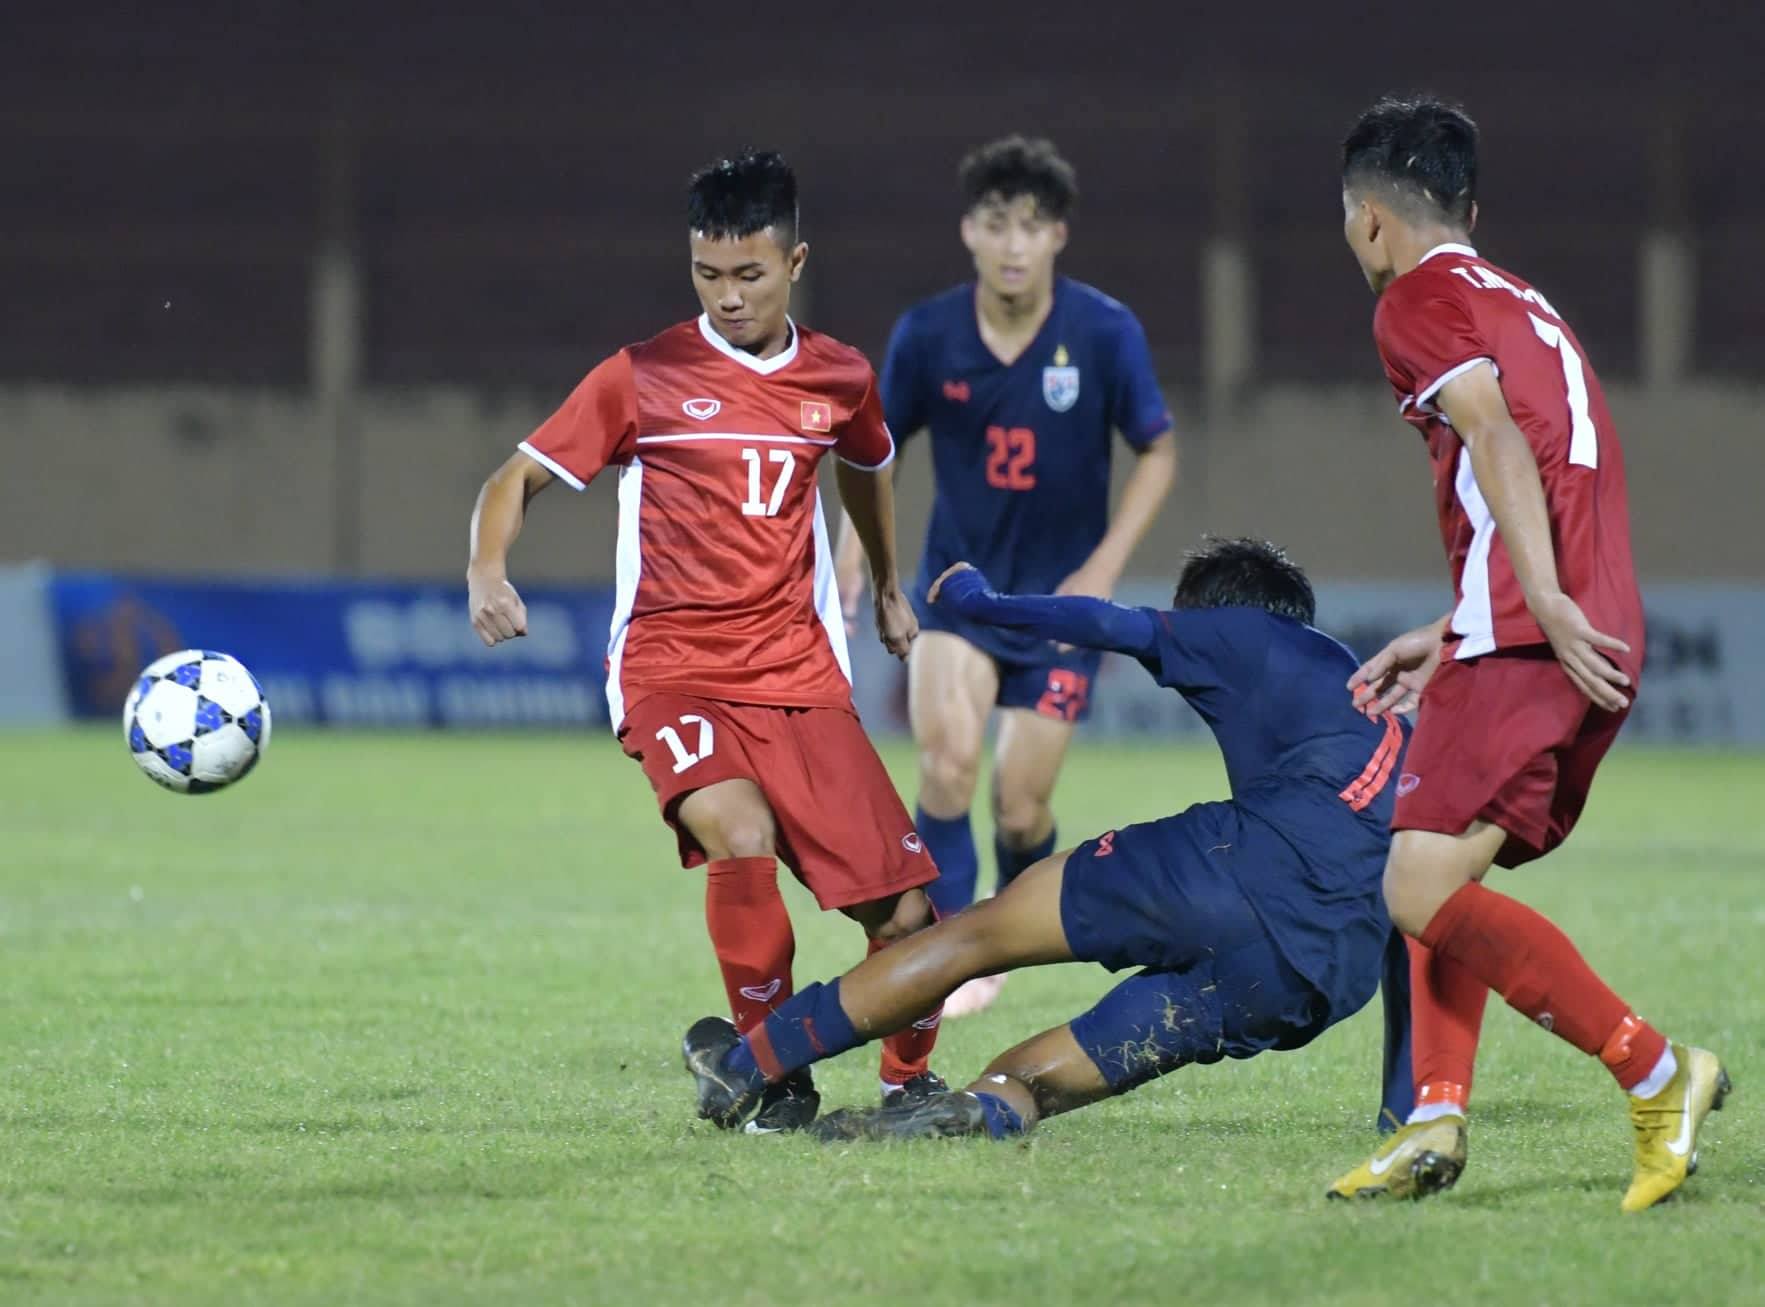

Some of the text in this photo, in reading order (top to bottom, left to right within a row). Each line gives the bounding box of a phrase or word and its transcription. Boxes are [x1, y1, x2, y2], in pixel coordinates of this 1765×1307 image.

[741, 447, 796, 517] 17
[985, 425, 1037, 491] 22
[655, 714, 714, 774] 17
